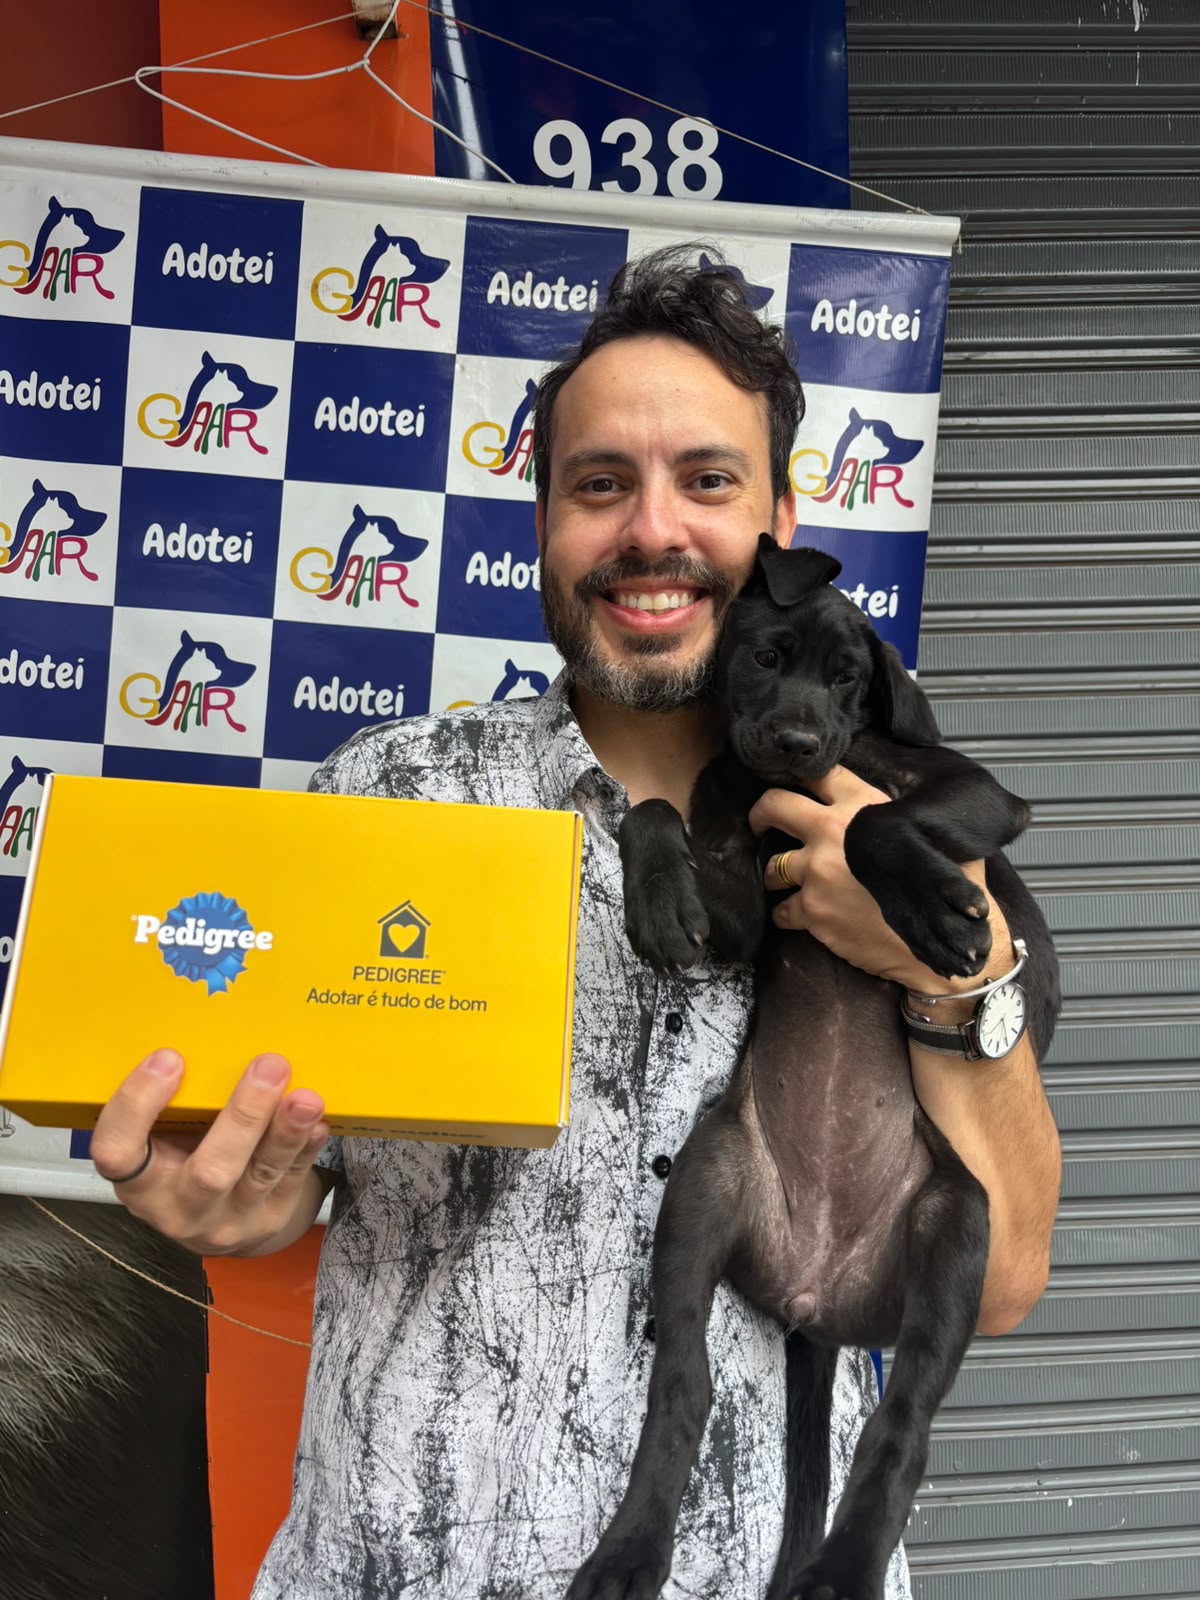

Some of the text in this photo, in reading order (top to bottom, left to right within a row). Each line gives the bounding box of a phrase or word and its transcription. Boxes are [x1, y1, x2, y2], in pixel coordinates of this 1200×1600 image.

[533, 117, 724, 201] 938
[163, 242, 274, 285] Adotei
[311, 267, 440, 329] GAAR
[487, 271, 599, 313] Adotei
[810, 300, 920, 342] Adotei
[0, 369, 101, 411] Adotei
[137, 393, 268, 455] GAAR
[315, 396, 426, 438] Adotei
[462, 421, 534, 482] GA
[788, 448, 915, 512] GAAR
[0, 522, 98, 582] AAR
[143, 522, 254, 564] Adotei
[290, 547, 419, 608] GAAR
[466, 551, 541, 592] Adot
[0, 649, 84, 690] dotei
[119, 672, 246, 733] GAAR
[294, 676, 405, 717] Adotei
[133, 914, 274, 956] Pedigree
[353, 965, 443, 985] PEDIGREE
[306, 987, 488, 1013] Adotar é tudo de bom
